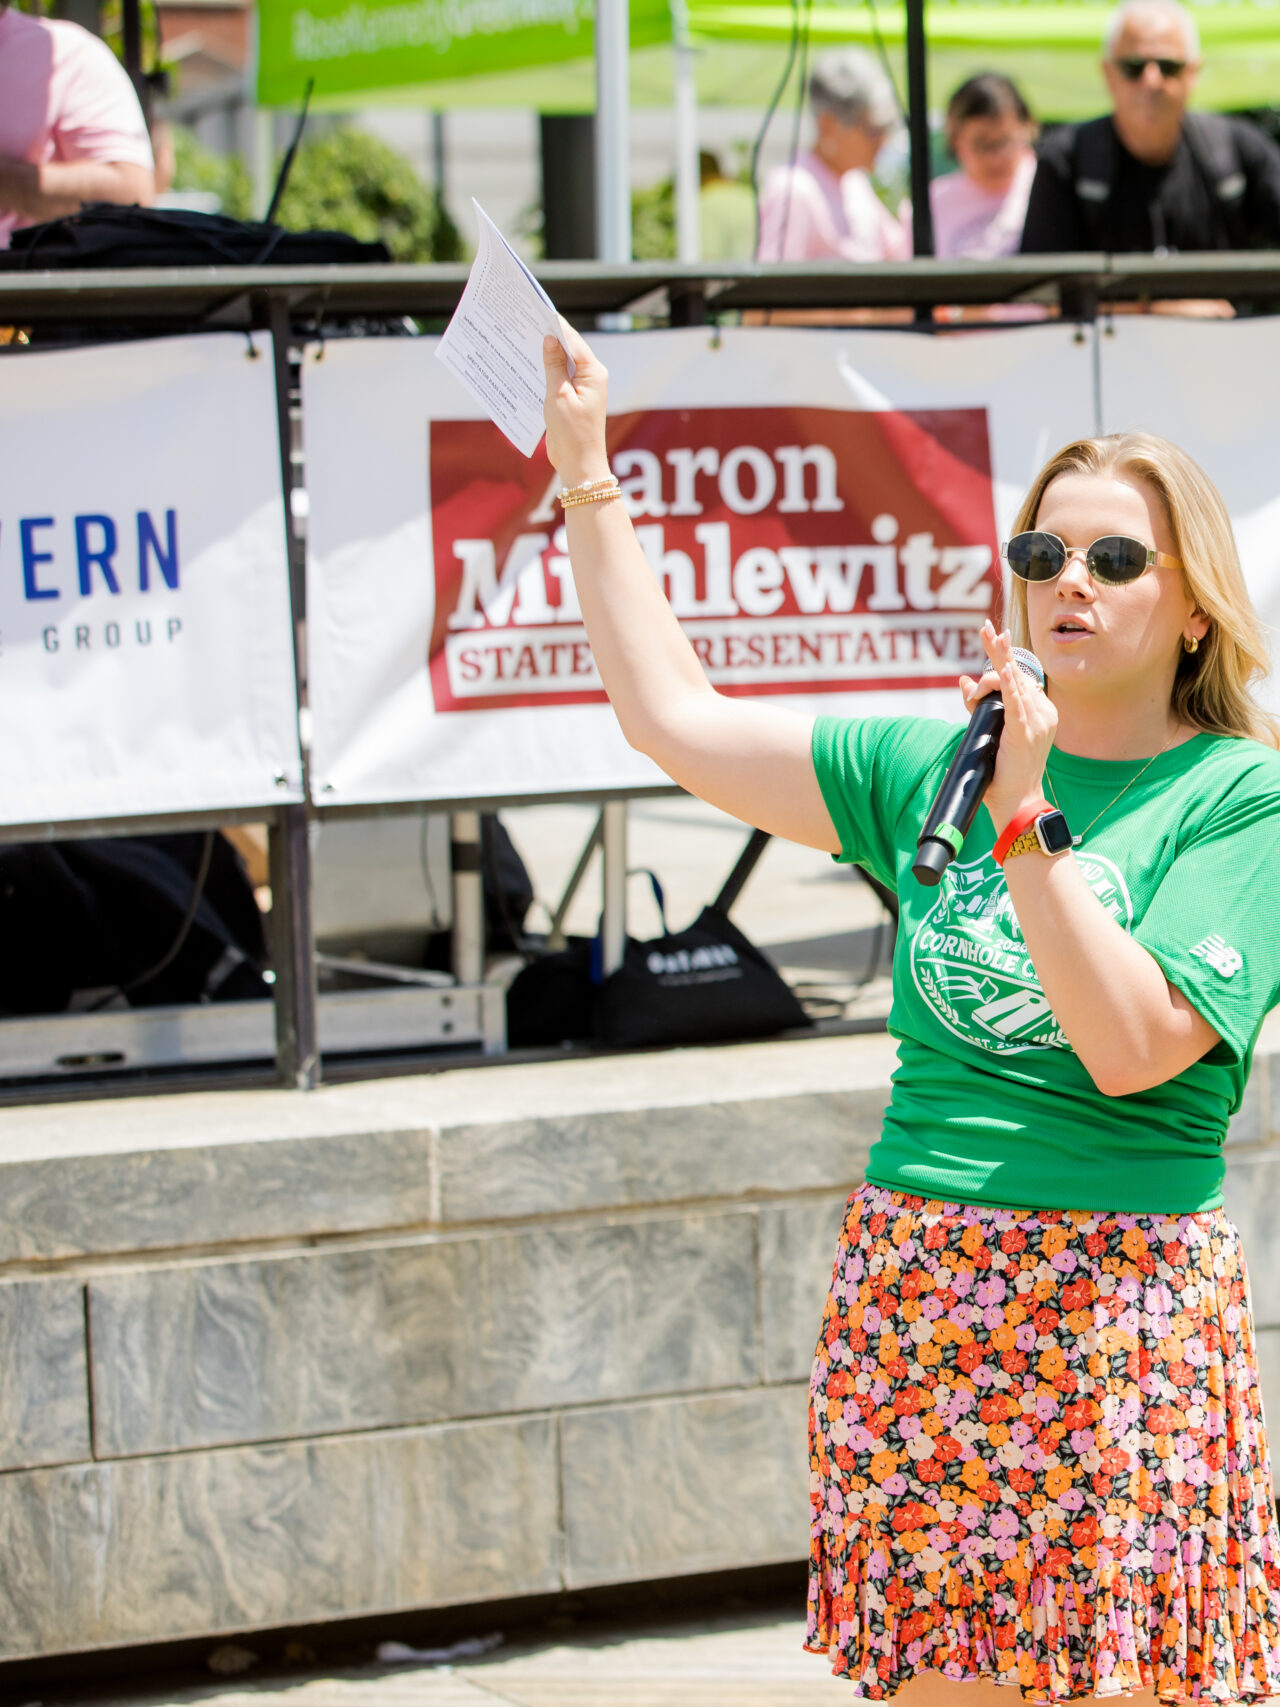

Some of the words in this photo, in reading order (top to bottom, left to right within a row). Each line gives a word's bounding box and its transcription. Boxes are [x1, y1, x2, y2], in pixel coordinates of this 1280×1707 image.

[18, 508, 181, 601] ERN
[448, 513, 994, 630] Mihlewitz
[42, 617, 183, 654] GROUP
[459, 642, 594, 684] STATE
[690, 627, 981, 670] RESENTATIVE
[918, 929, 1021, 974] CORNHOLE
